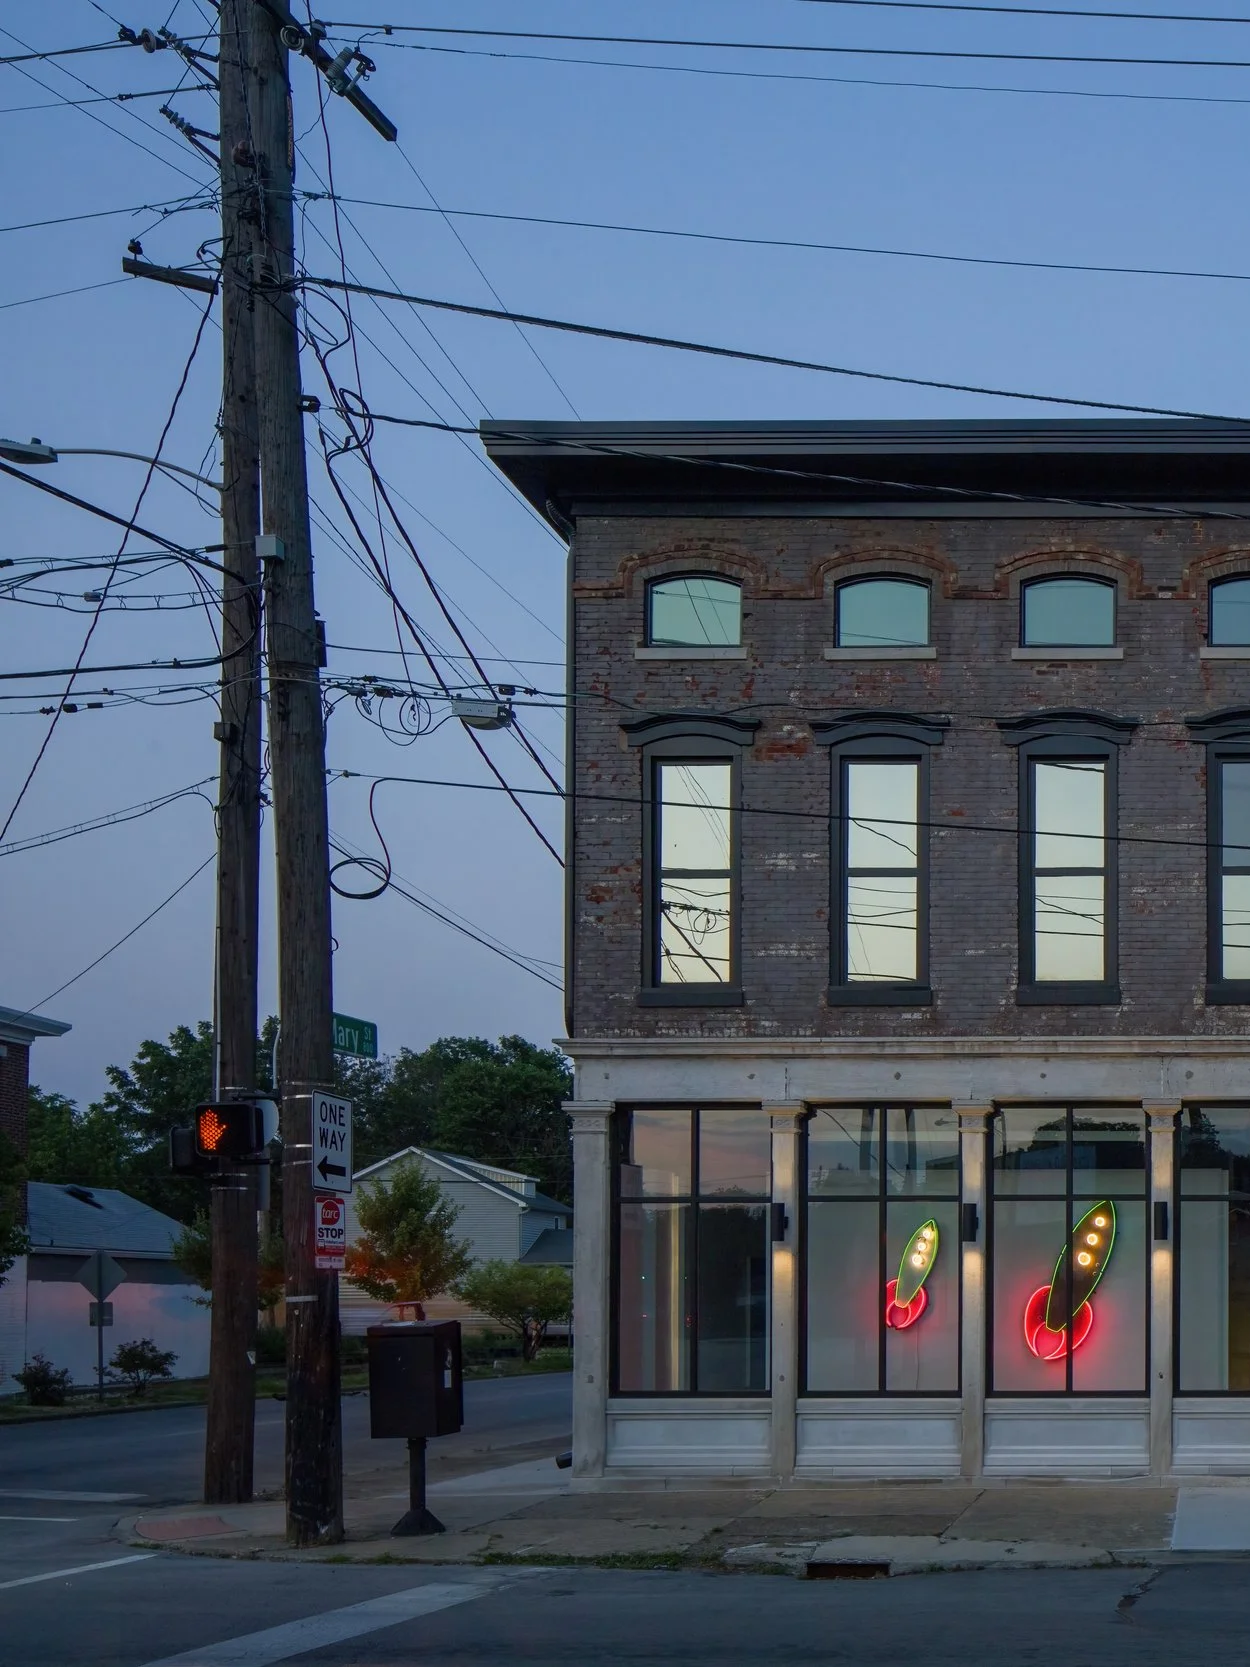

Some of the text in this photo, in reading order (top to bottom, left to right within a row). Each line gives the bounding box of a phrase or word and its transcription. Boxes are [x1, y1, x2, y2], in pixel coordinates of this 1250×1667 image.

[364, 1026, 371, 1041] St
[320, 1101, 345, 1126] ONE
[319, 1127, 346, 1152] WAY
[322, 1209, 338, 1219] tarc
[318, 1228, 343, 1239] STOP
